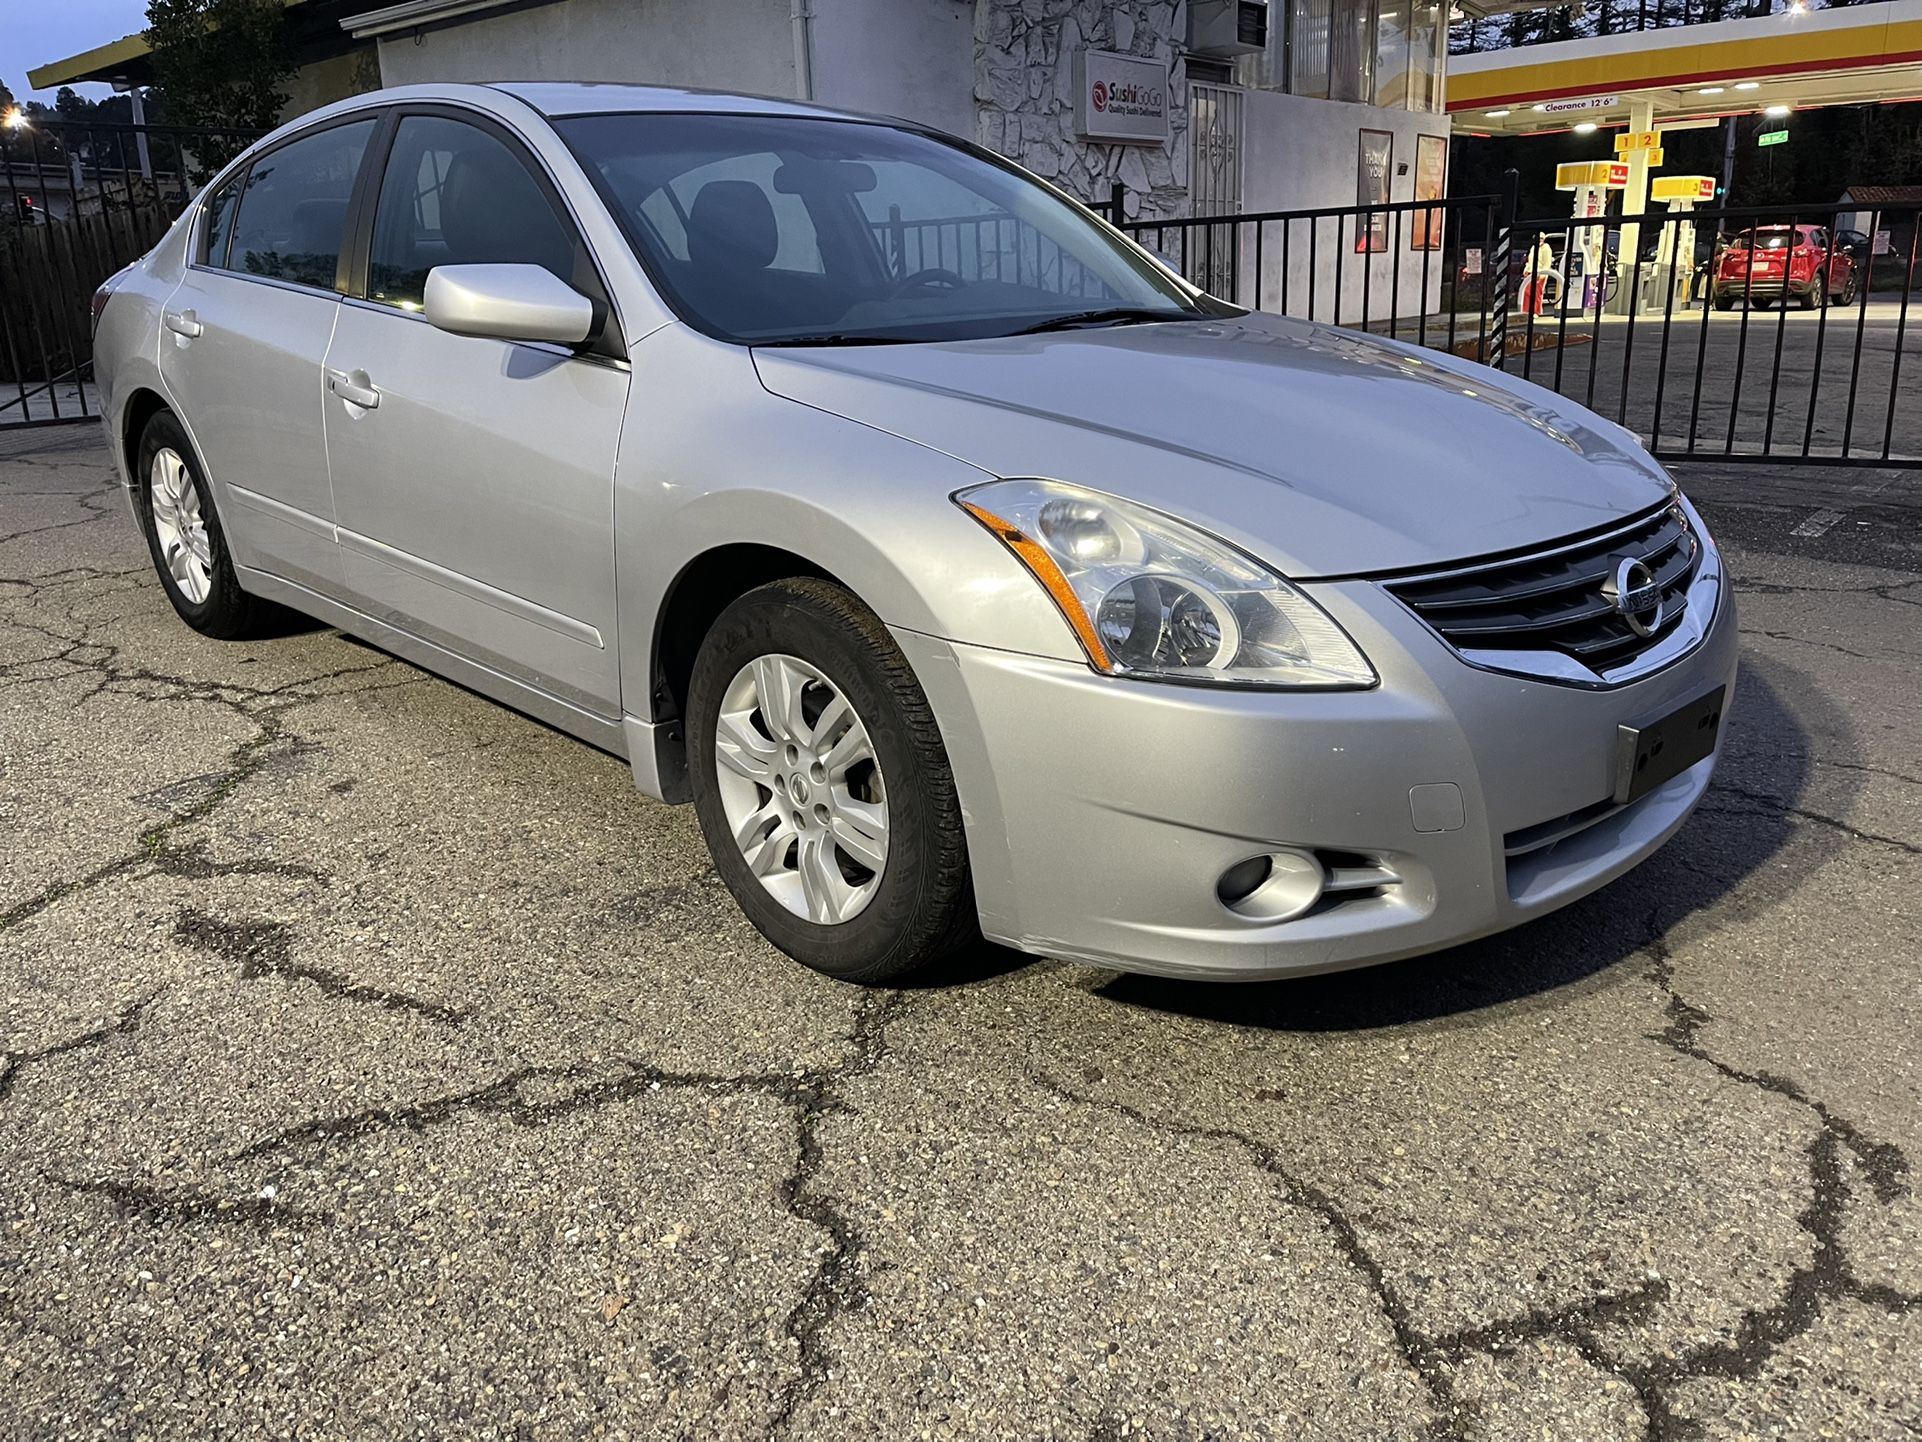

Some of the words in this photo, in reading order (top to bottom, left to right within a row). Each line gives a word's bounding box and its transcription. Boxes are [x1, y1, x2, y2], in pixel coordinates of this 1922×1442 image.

[1109, 82, 1162, 107] SushiGoGo
[1126, 106, 1139, 116] Sushi
[1545, 103, 1586, 112] Clearance
[1624, 137, 1628, 147] 1
[1644, 135, 1651, 145] 2
[1369, 166, 1383, 178] YOU
[1602, 169, 1608, 178] 2
